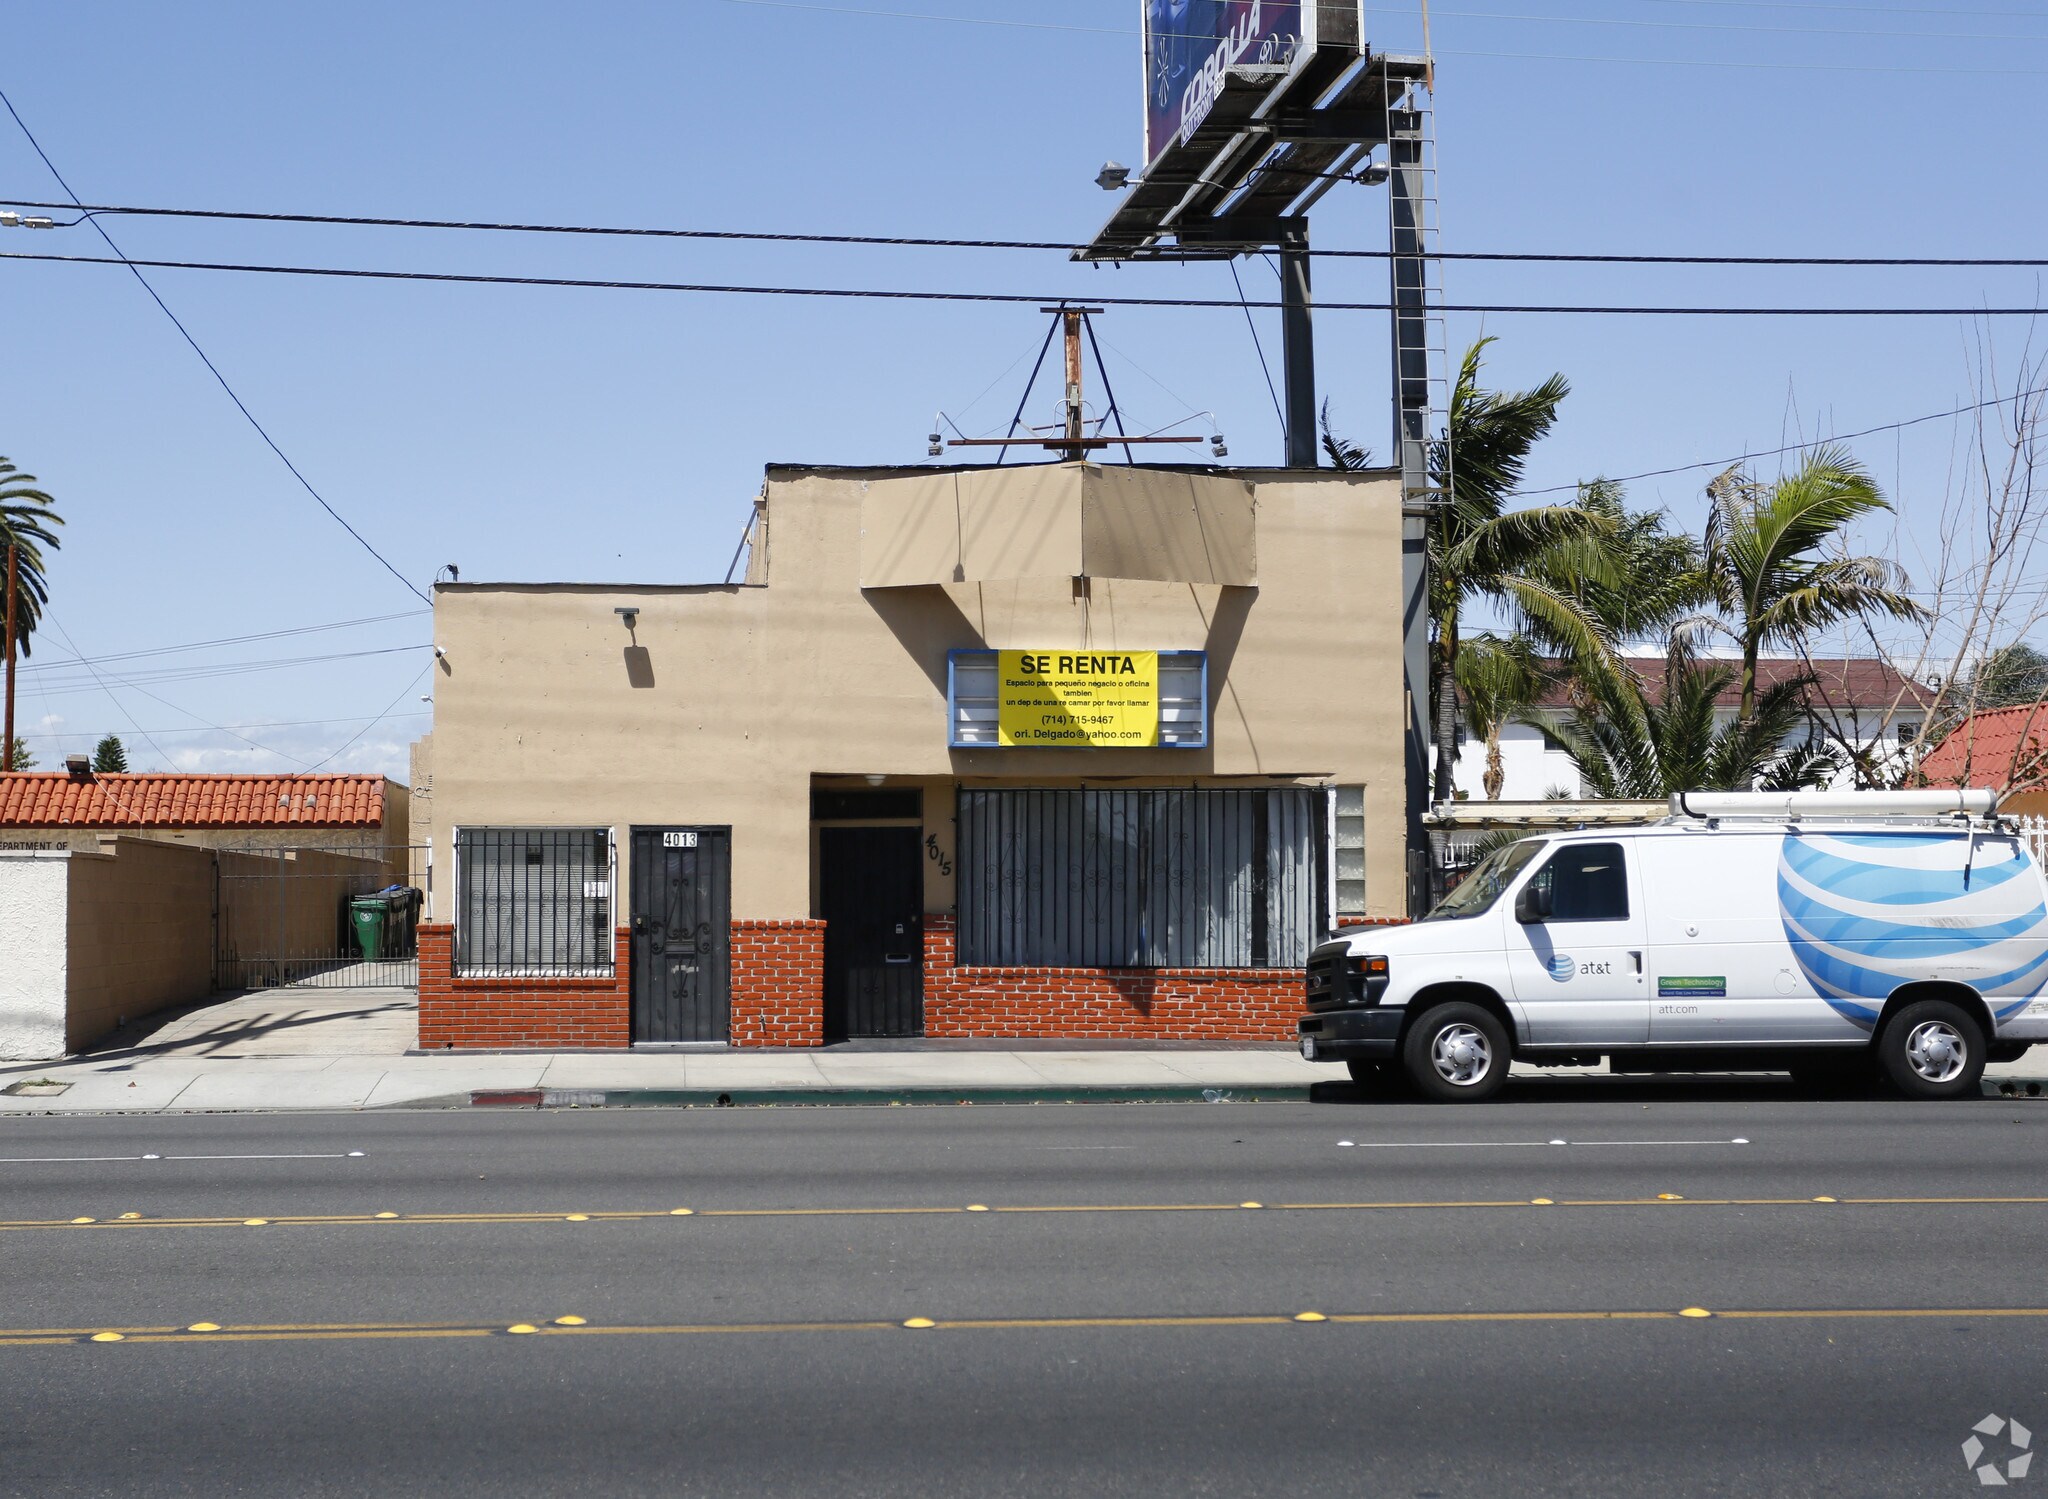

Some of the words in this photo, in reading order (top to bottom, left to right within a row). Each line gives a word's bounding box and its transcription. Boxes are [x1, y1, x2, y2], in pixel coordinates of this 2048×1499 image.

[1181, 0, 1260, 124] COROLLA
[1181, 89, 1213, 142] OUTFRONT
[1020, 655, 1050, 675] SE
[1059, 655, 1136, 675] RENTA
[1006, 680, 1035, 688] Espacio
[1055, 680, 1087, 688] pequeño
[1017, 699, 1032, 707] dep
[1041, 715, 1067, 726] (714)
[1070, 715, 1114, 725] 715-9467
[1014, 729, 1031, 739] ori.
[1034, 729, 1142, 741] Delgado@yahoo.com
[56, 841, 68, 850] OF
[664, 833, 697, 847] 4013
[925, 832, 952, 876] 4015
[1580, 961, 1612, 975] at&t
[1660, 978, 1681, 986] Green
[1684, 978, 1724, 987] Technology
[1658, 1005, 1698, 1014] att.com
